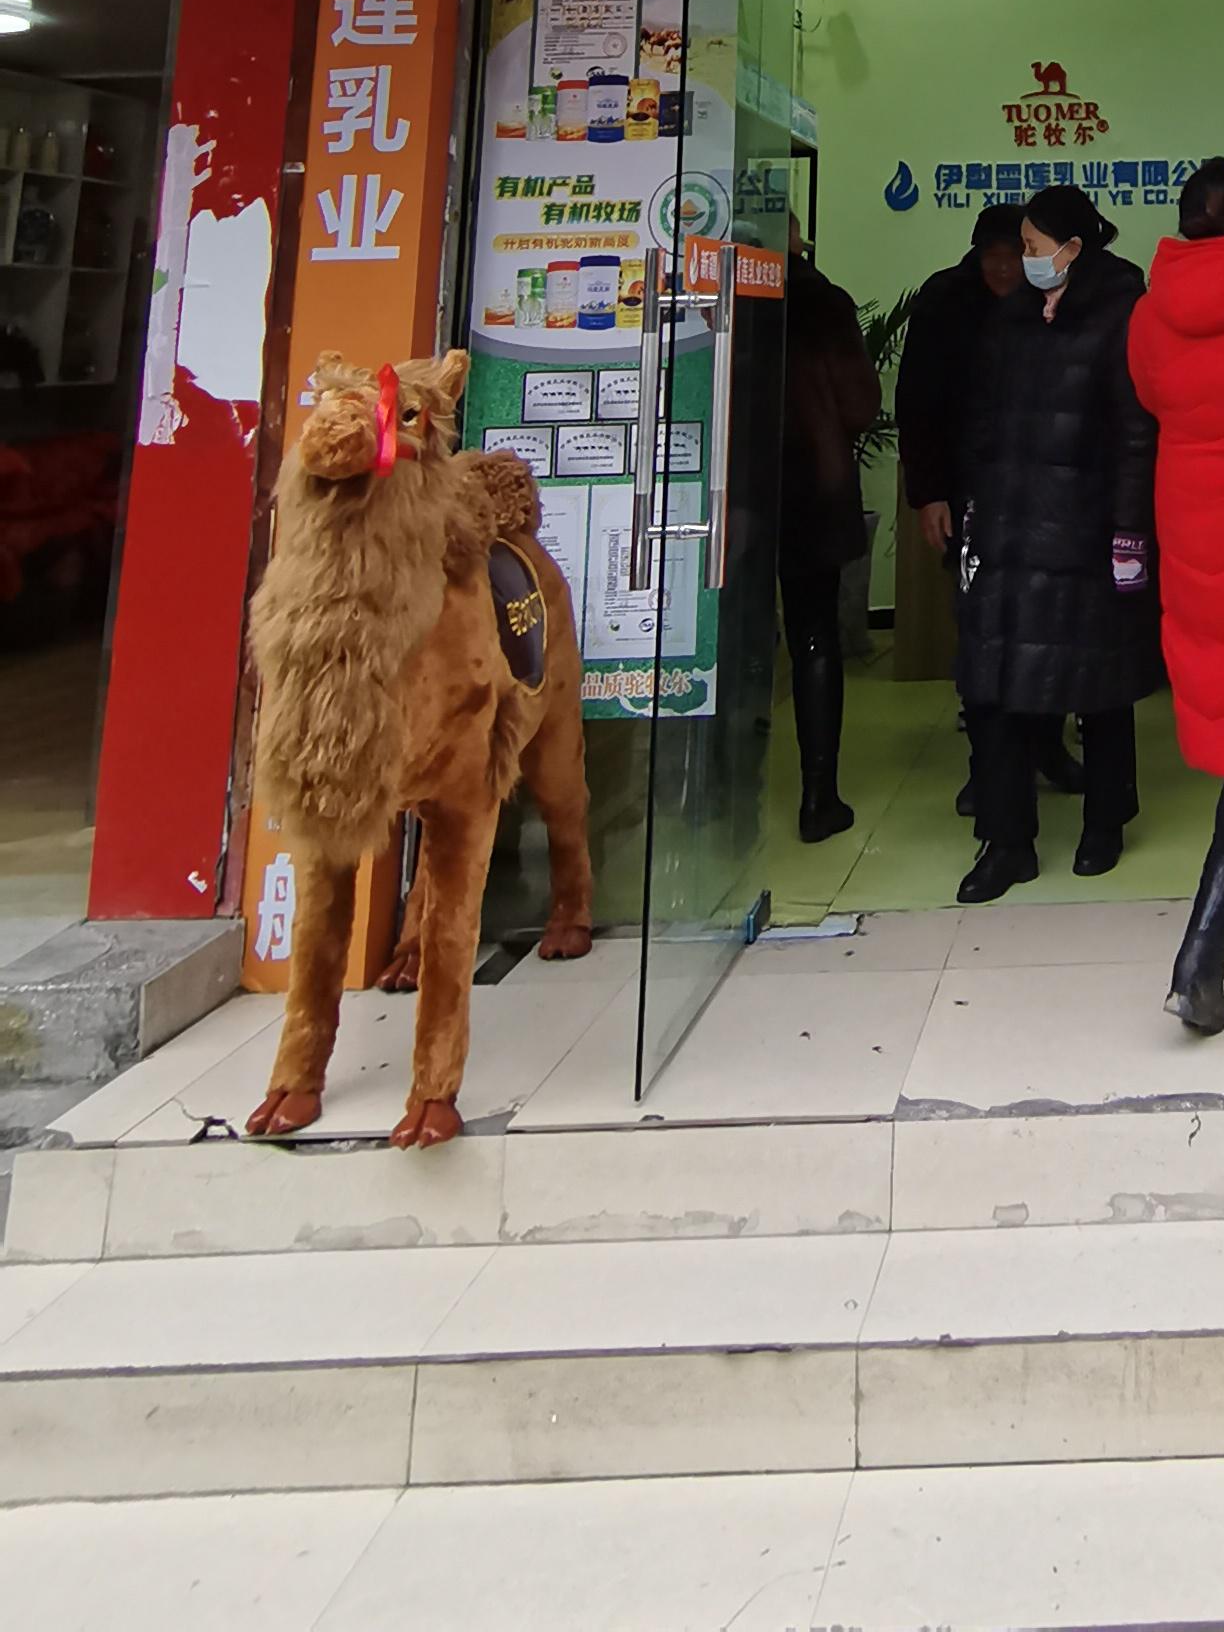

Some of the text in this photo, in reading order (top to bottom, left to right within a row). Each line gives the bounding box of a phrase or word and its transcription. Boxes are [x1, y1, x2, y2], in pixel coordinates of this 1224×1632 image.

[1001, 101, 1100, 123] TUOMER
[1014, 122, 1096, 148] 驼牧尔
[495, 174, 597, 199] 有机产品
[540, 200, 643, 225] 有机牧场
[934, 192, 971, 208] YILI
